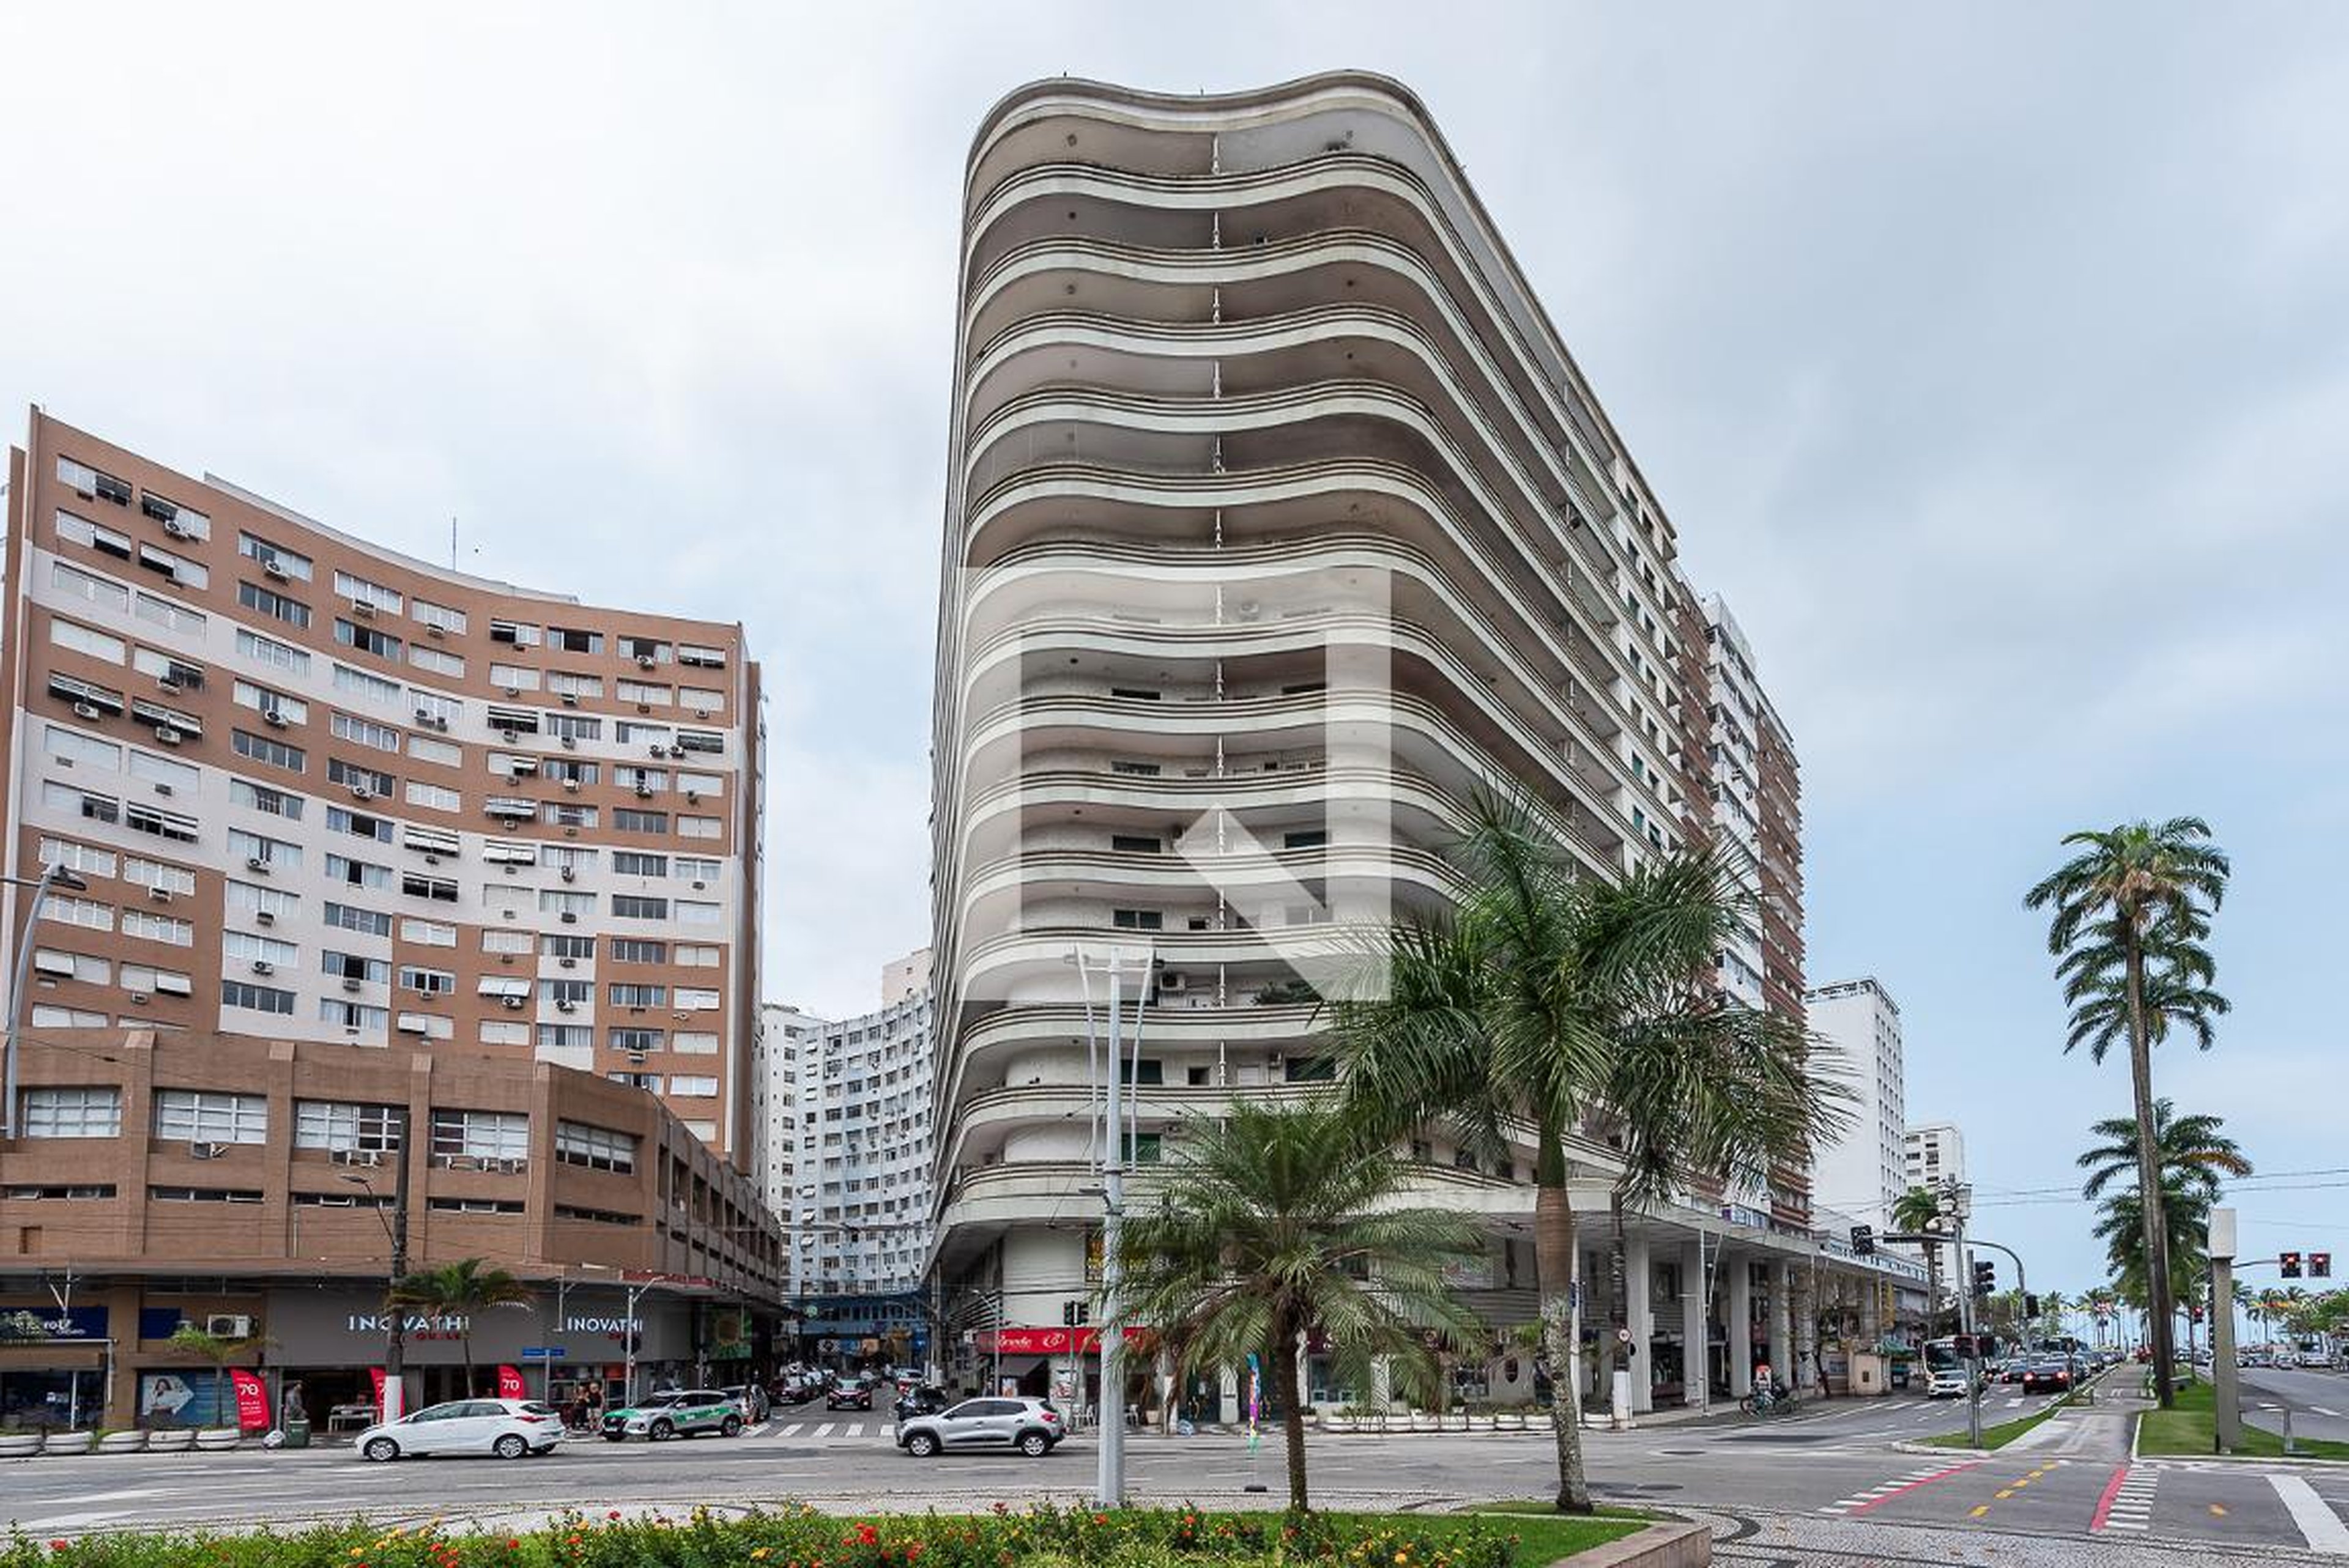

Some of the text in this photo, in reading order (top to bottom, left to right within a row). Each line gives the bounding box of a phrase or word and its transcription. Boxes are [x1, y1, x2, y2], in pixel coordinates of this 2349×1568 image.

[567, 1317, 642, 1332] INOVATHI
[237, 1383, 259, 1395] 70
[502, 1379, 519, 1391] 70
